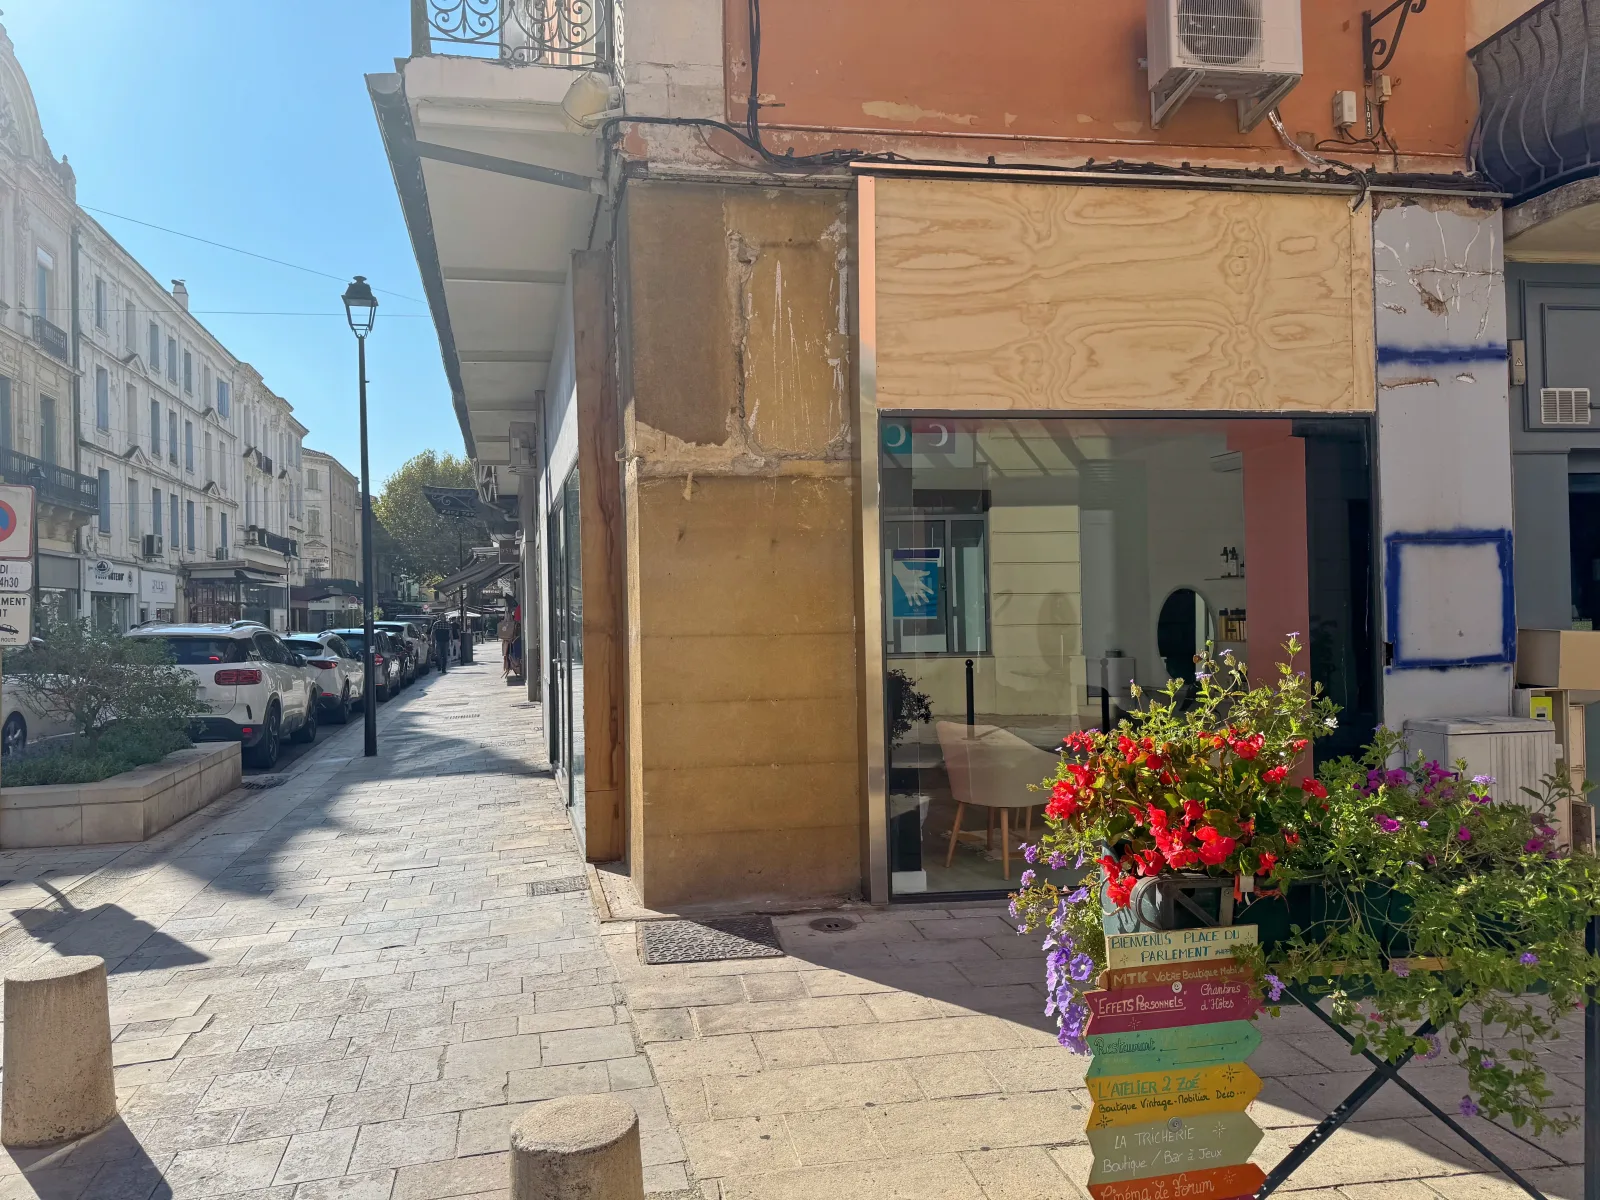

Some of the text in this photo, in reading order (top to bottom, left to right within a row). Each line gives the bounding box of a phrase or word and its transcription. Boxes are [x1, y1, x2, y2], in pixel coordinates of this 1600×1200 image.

[1111, 929, 1240, 949] BIENVENUS PLACE DU
[1140, 945, 1212, 963] PARLEMENT
[1113, 970, 1149, 987] MTK
[1182, 967, 1219, 981] Boutique
[1200, 982, 1241, 996] Chambres
[1200, 996, 1235, 1011] d'Hôtes
[1093, 1036, 1156, 1056] Restaurant
[1162, 1075, 1172, 1092] 2
[1098, 1101, 1137, 1114] Boutique
[1114, 1135, 1127, 1150] LA
[1102, 1155, 1148, 1176] Boutique
[1164, 1150, 1184, 1165] Bar
[1187, 1148, 1194, 1161] à
[1198, 1147, 1223, 1160] Jeux
[1172, 1173, 1215, 1198] Forum
